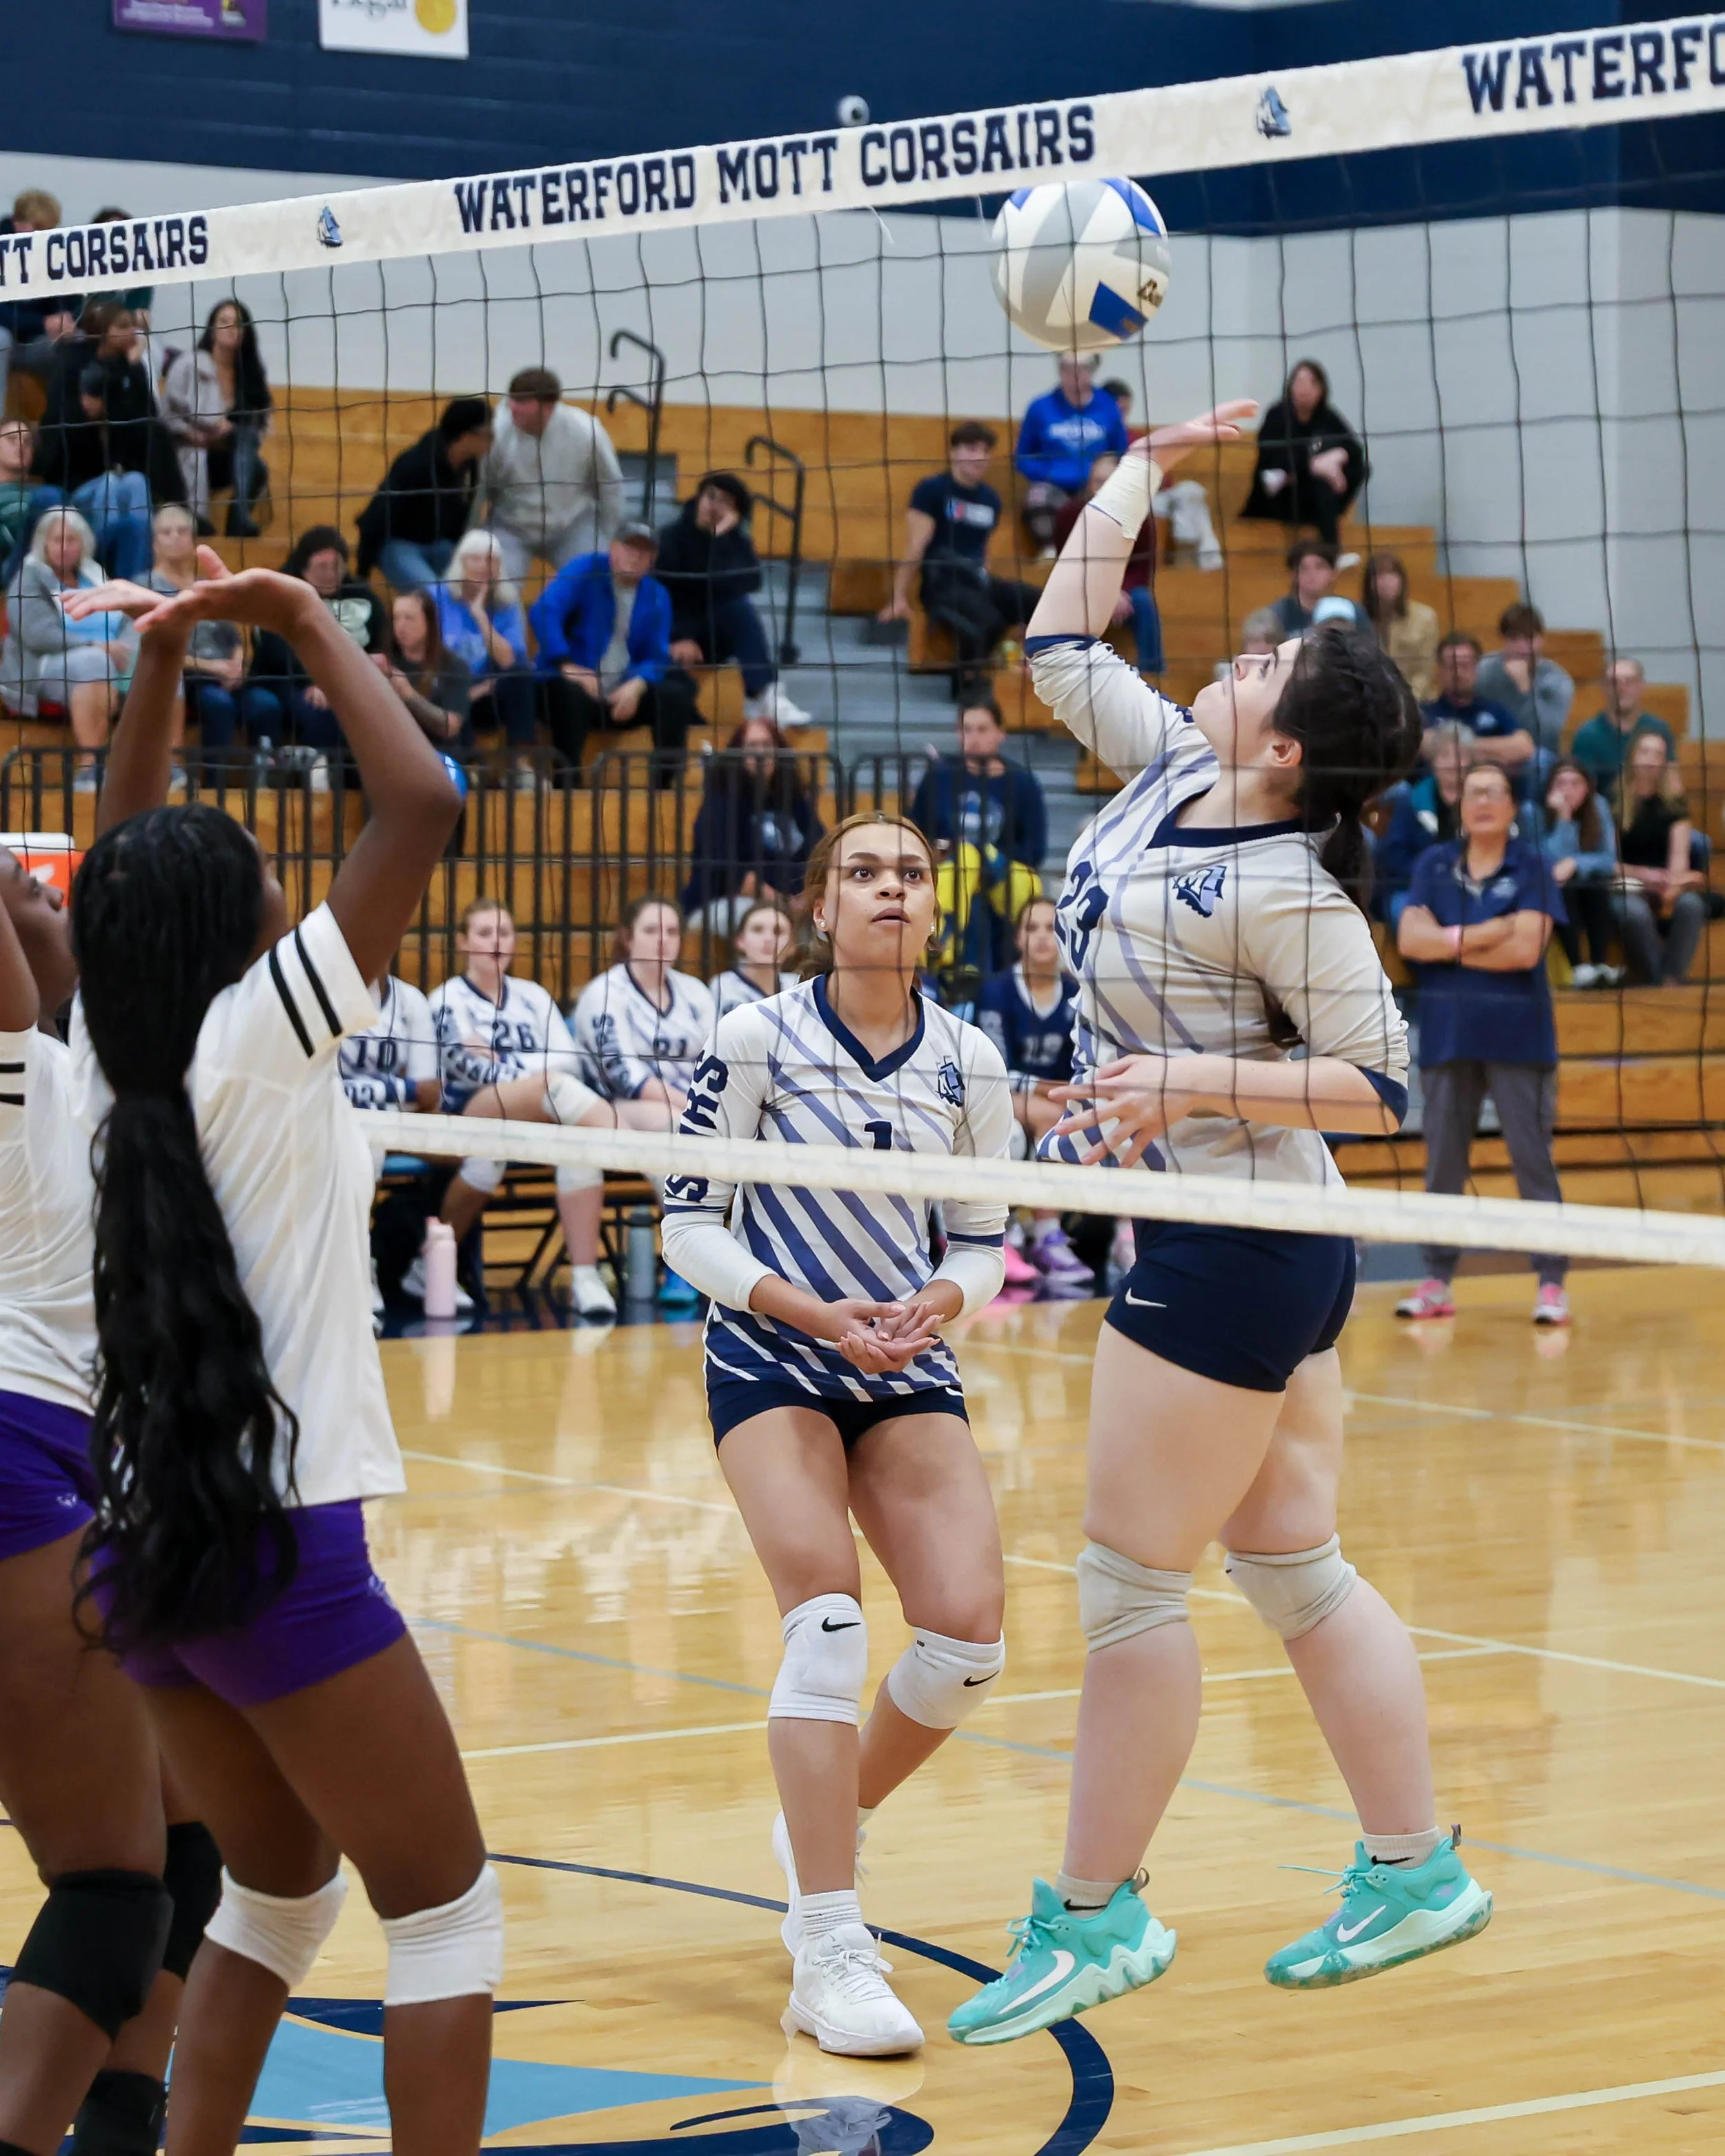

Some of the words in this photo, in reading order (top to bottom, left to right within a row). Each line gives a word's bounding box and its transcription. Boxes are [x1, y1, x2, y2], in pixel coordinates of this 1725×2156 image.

[454, 153, 696, 233] WATERFORD
[716, 136, 838, 204] MOTT
[860, 103, 1095, 186] CORSAIRS
[47, 215, 208, 280] CORSAIRS
[354, 1036, 397, 1074] 10
[494, 1020, 535, 1052] 26
